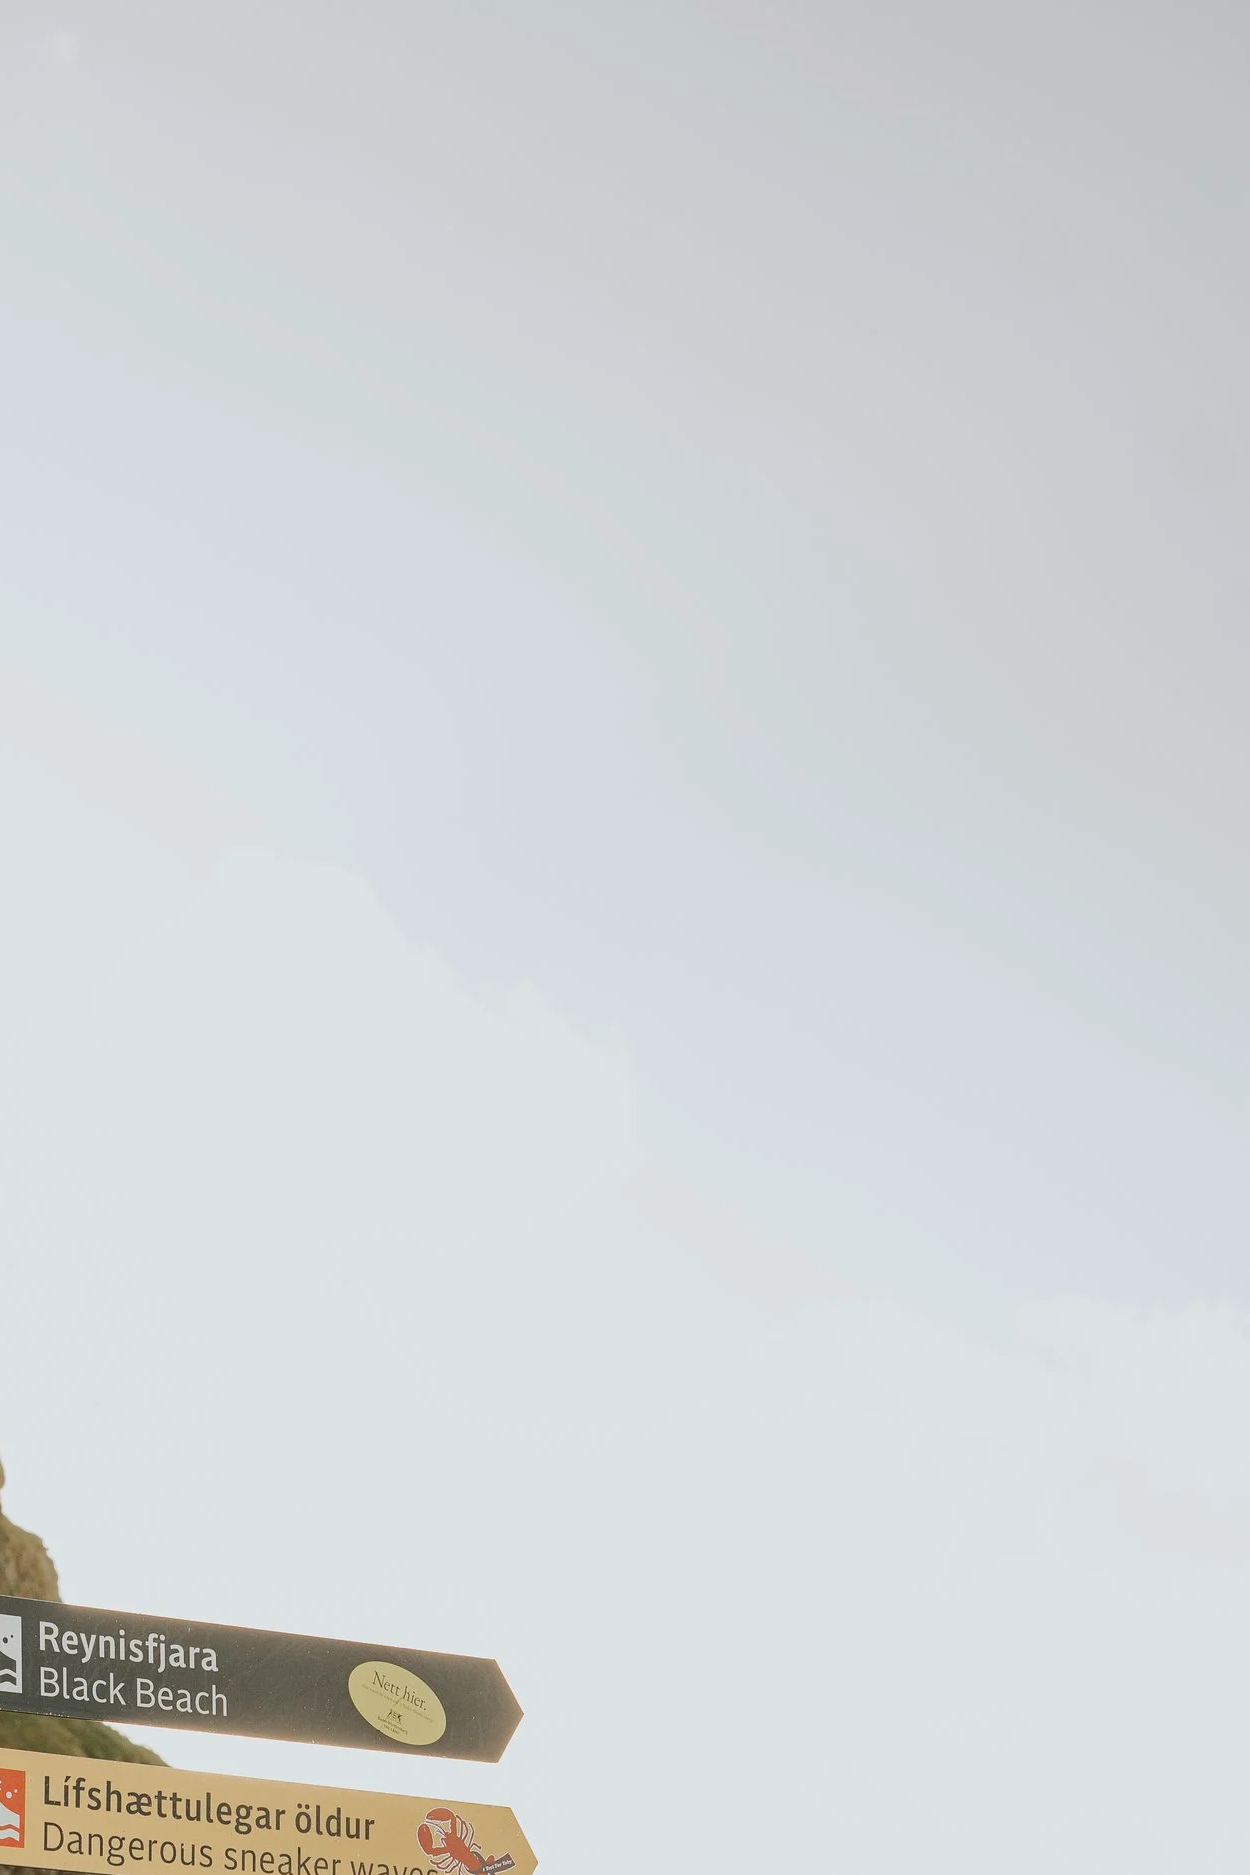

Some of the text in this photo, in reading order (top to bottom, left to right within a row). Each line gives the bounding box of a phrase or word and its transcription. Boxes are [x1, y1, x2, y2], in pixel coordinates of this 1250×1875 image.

[39, 1621, 219, 1673] Reynisfjara
[40, 1666, 227, 1717] Black Beach
[372, 1670, 401, 1697] Nett
[402, 1685, 427, 1711] hier.
[44, 1775, 375, 1841] Lífshættulegar öldur
[43, 1821, 213, 1868] Dangerous
